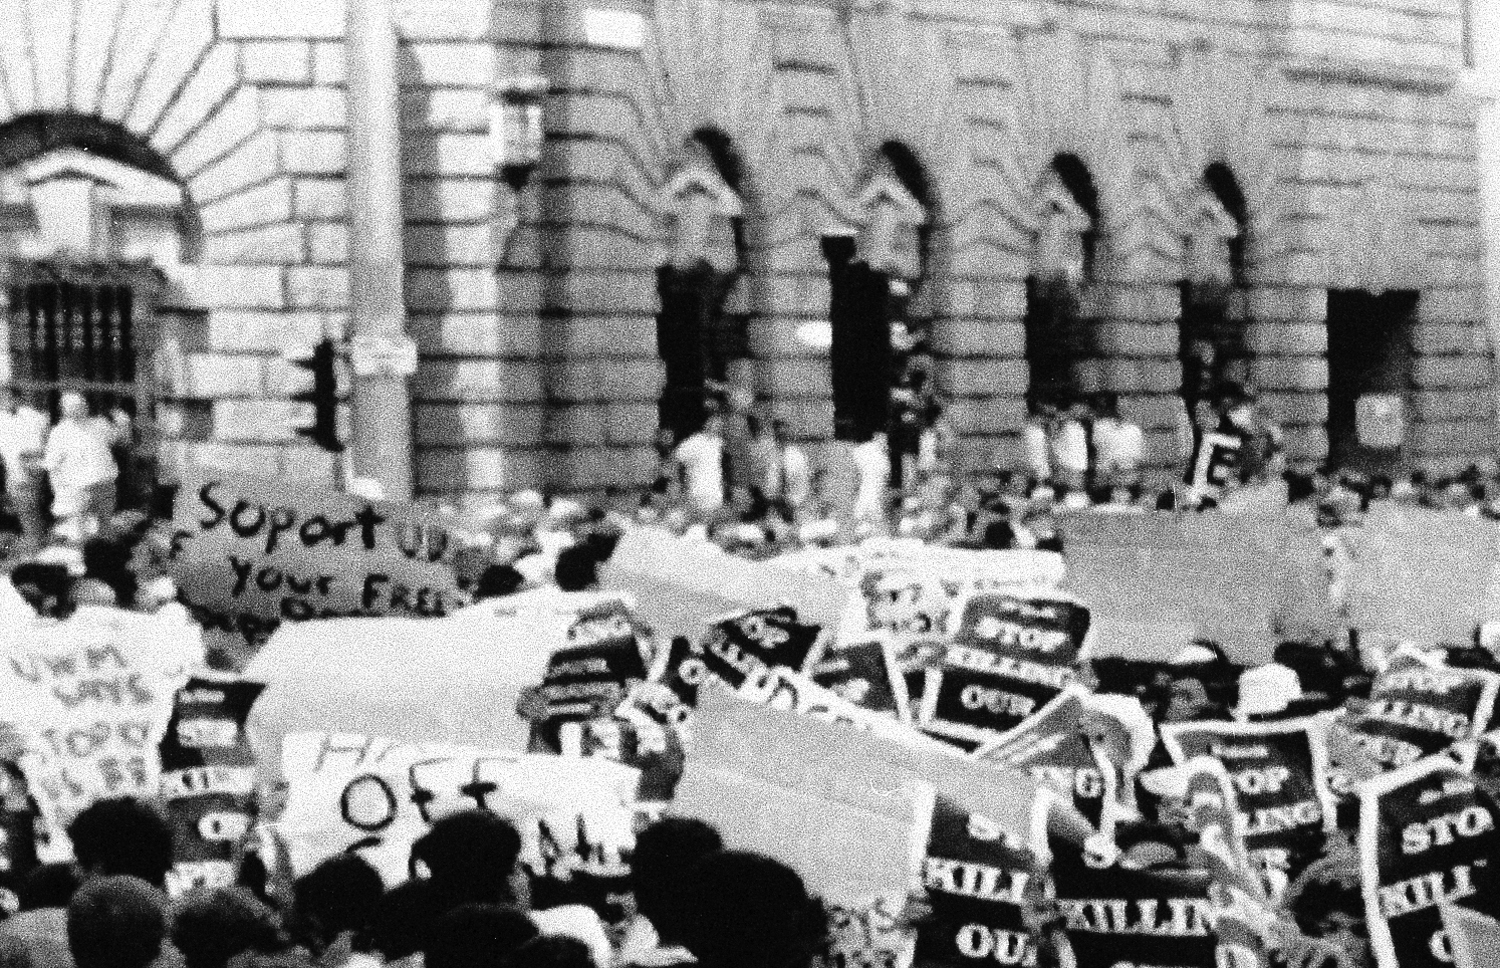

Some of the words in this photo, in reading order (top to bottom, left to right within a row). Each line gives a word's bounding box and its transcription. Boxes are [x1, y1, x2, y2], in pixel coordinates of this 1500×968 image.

[1401, 806, 1493, 855] STO
[924, 857, 1030, 904] KILL
[1061, 900, 1215, 937] KILLIN
